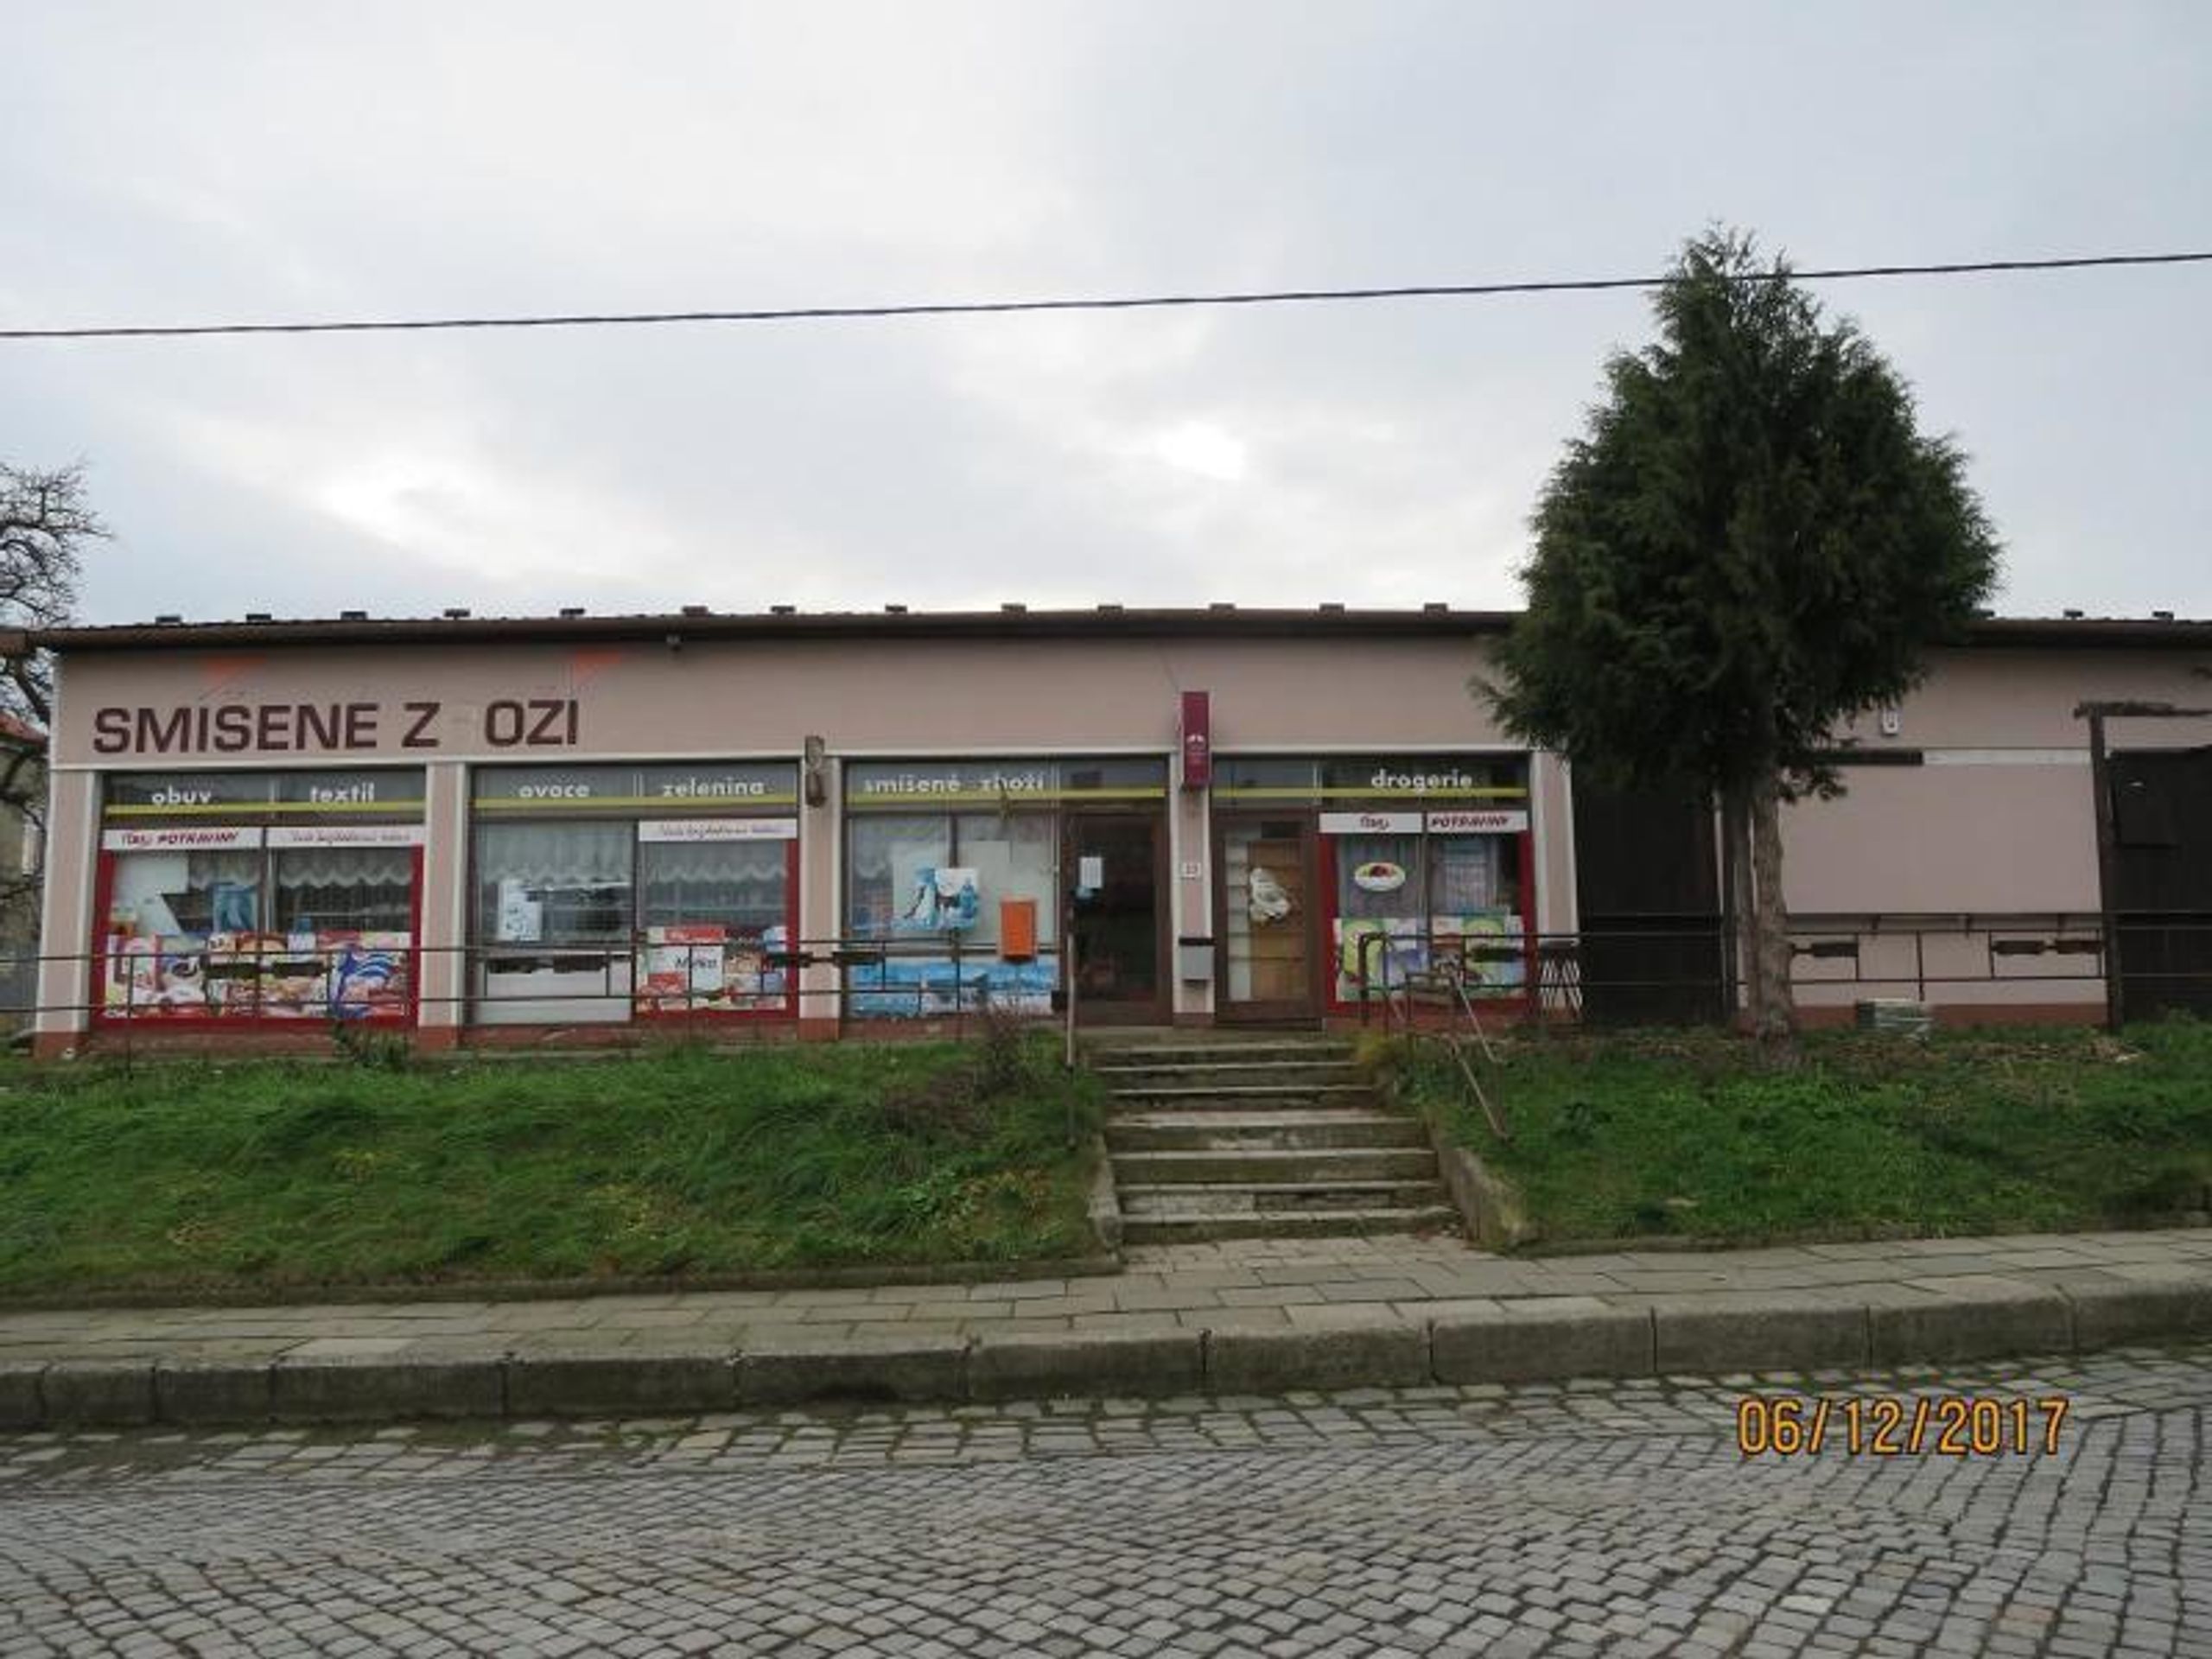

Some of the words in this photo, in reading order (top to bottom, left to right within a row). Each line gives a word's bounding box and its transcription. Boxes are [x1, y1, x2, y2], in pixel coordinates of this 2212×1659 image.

[93, 702, 378, 754] SMISENE
[519, 783, 590, 798] ovoce
[662, 776, 765, 798] zelenina
[1371, 768, 1473, 793] drogerie
[151, 785, 213, 804] obuv
[309, 782, 375, 804] textil
